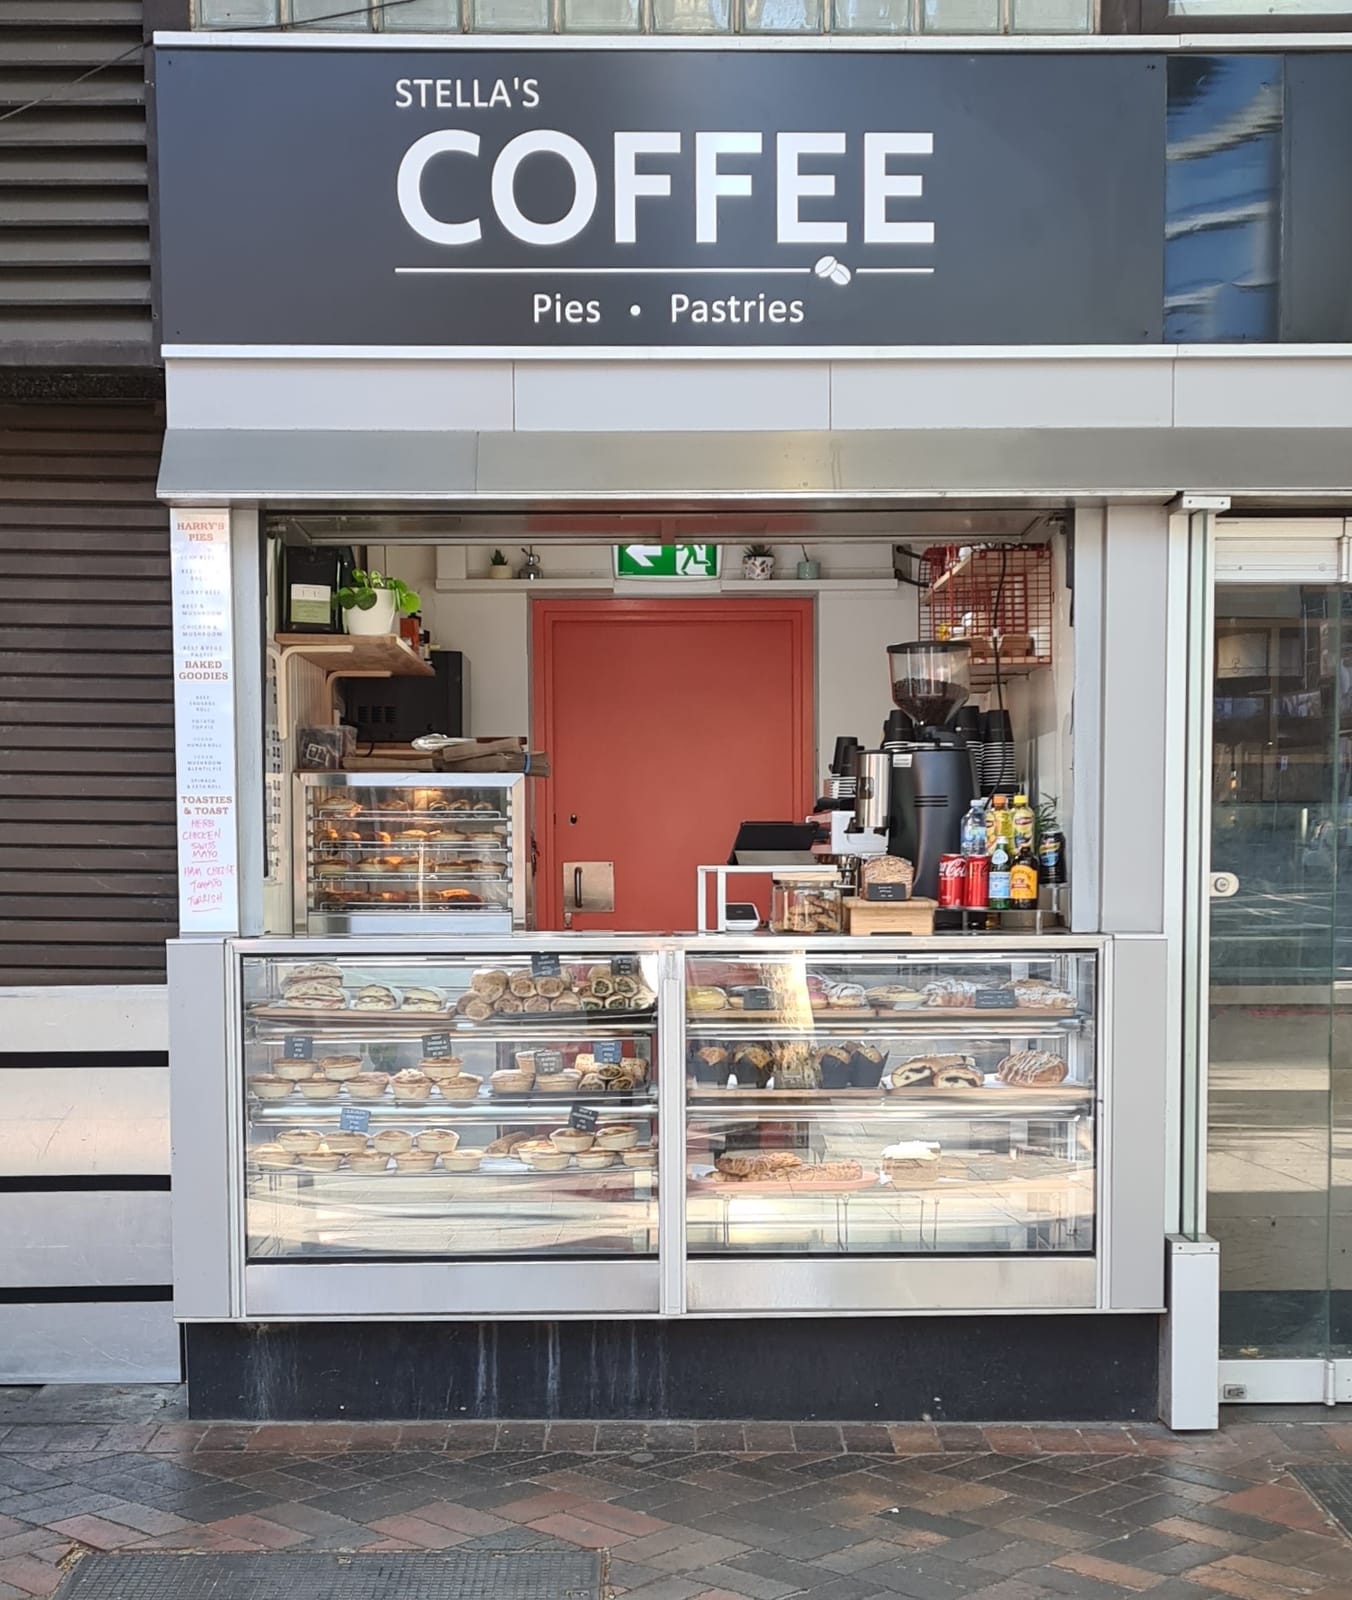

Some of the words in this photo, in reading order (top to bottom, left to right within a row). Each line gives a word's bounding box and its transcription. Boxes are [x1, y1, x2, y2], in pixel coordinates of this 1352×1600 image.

[395, 78, 540, 109] STELLA'S
[396, 128, 935, 246] COFFEE
[533, 293, 601, 325] Pies
[670, 293, 805, 325] Pastries
[177, 522, 225, 531] HARRY'S
[189, 533, 213, 542] PIES
[185, 661, 223, 669] BAKED
[179, 672, 229, 681] GOODIES
[181, 796, 233, 805] TOASTIES
[184, 807, 192, 815] &
[194, 807, 229, 815] TOAST
